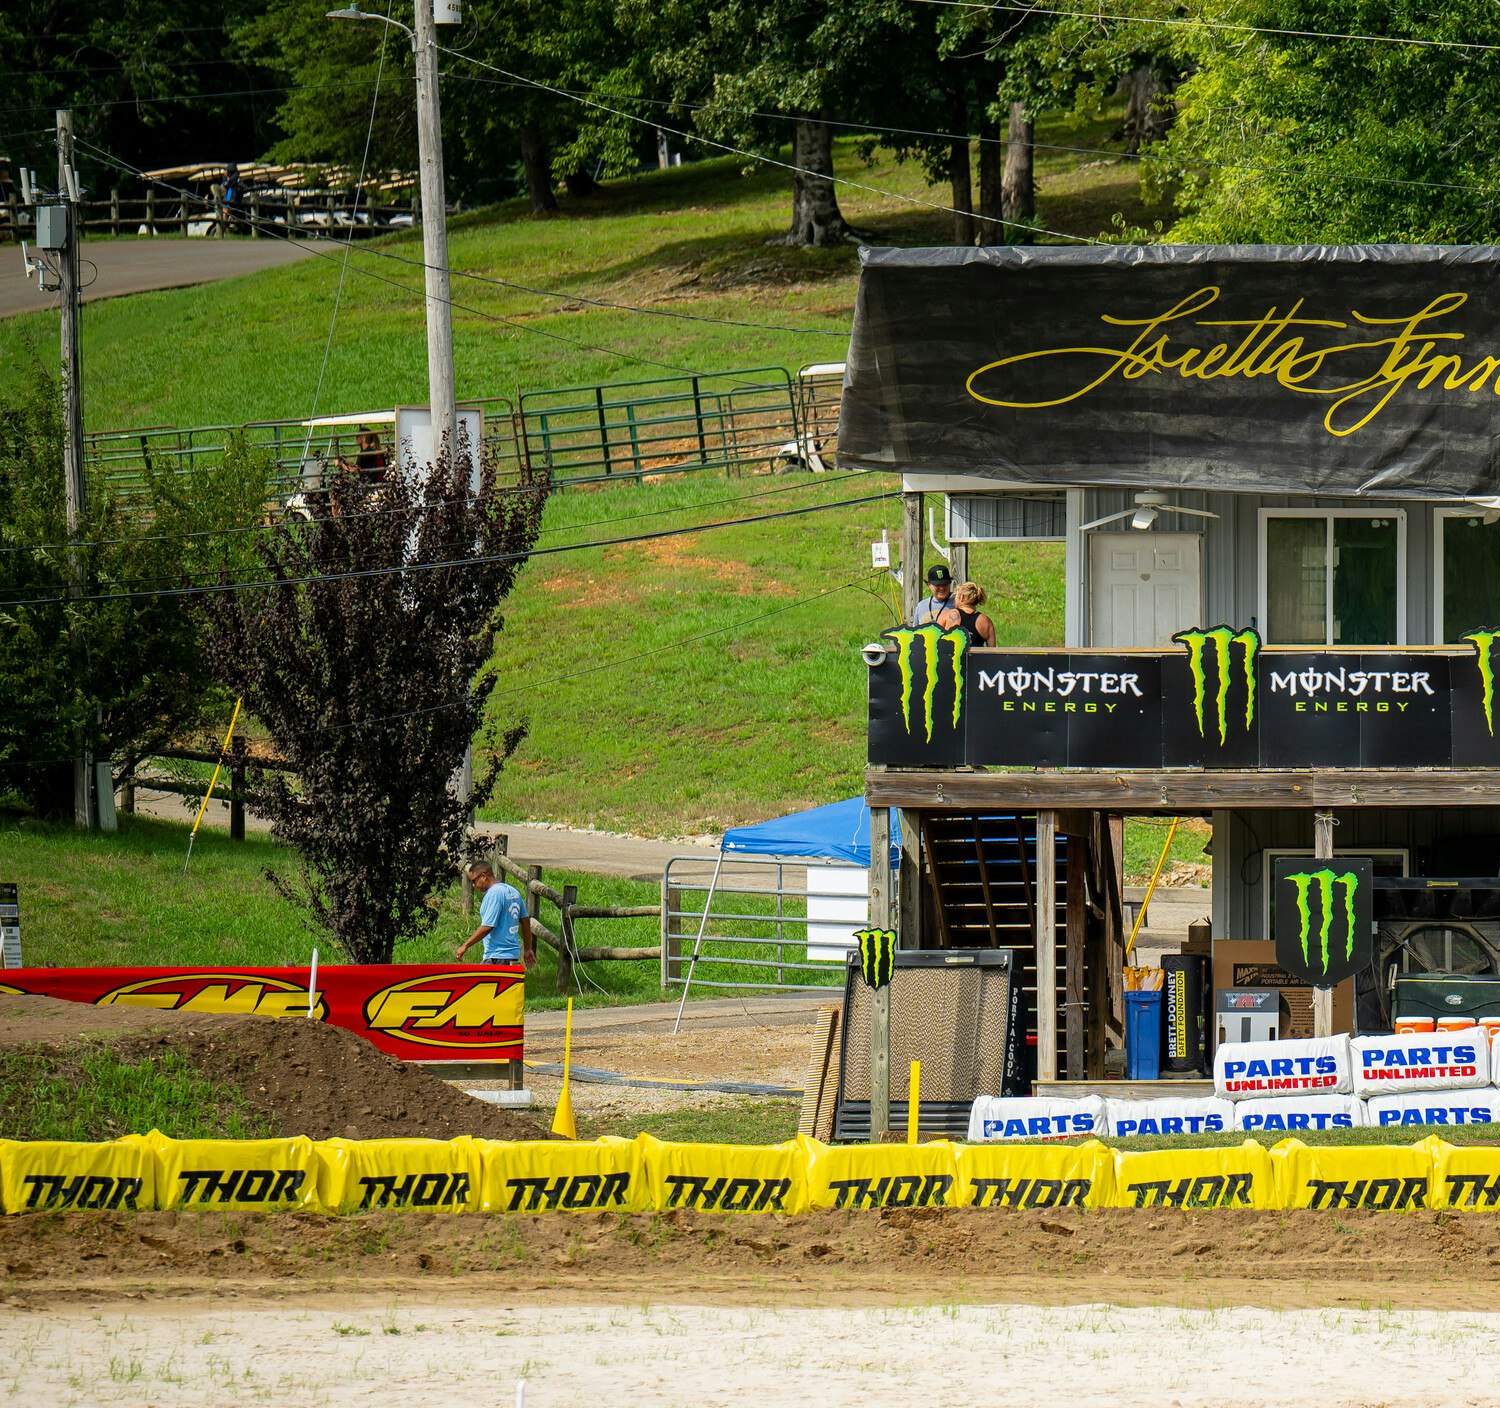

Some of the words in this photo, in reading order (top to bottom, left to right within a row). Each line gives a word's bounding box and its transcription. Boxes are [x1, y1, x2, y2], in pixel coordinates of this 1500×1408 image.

[966, 286, 1346, 408] Loretta
[977, 666, 1144, 697] MONSTER
[1269, 667, 1435, 697] MONSTER
[1003, 701, 1118, 713] ENERGY
[1295, 702, 1410, 712] ENERGY
[1167, 971, 1176, 1022] DOWNEY
[1168, 1025, 1177, 1058] BRETT
[1362, 1045, 1476, 1067] PARTS
[1224, 1055, 1337, 1079] PARTS
[1363, 1066, 1476, 1080] UNLIMITED
[1226, 1076, 1337, 1092] UNLIMITED
[984, 1113, 1095, 1138] PARTS
[1117, 1113, 1223, 1137] PARTS
[1243, 1113, 1353, 1132] PARTS
[1379, 1107, 1492, 1127] PARTS
[23, 1175, 143, 1209] THOR
[177, 1169, 306, 1203] THOR
[358, 1172, 470, 1208] THOR
[505, 1171, 630, 1211] THOR
[664, 1175, 792, 1211] THOR
[827, 1174, 954, 1210] THOR
[968, 1178, 1092, 1209] THOR
[1127, 1172, 1254, 1208] THOR
[1306, 1176, 1429, 1211] THOR
